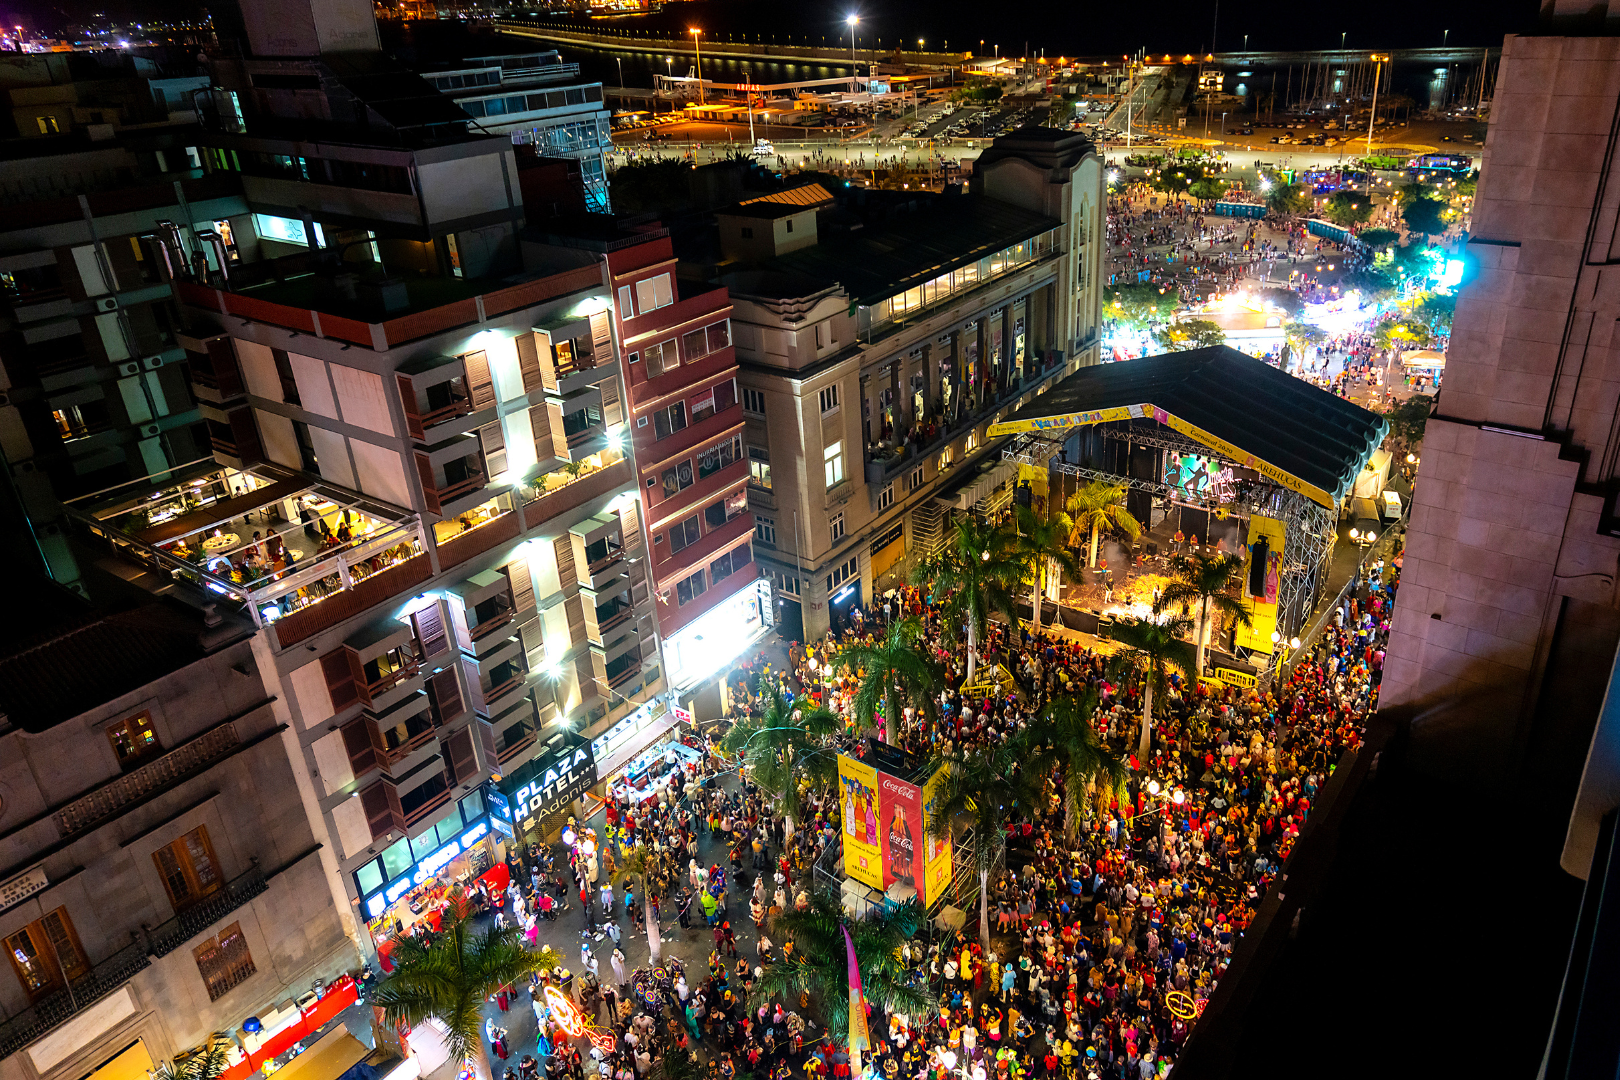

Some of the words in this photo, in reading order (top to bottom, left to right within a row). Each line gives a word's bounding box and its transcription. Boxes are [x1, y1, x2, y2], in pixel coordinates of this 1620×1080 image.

[1191, 430, 1218, 447] Carnaval
[1218, 443, 1233, 454] 2020
[1257, 463, 1303, 489] AREHUCAS
[515, 748, 588, 806] PLAZA
[513, 770, 580, 823] HOTEL
[538, 777, 592, 823] Adonis
[2, 876, 30, 895] PLAZA
